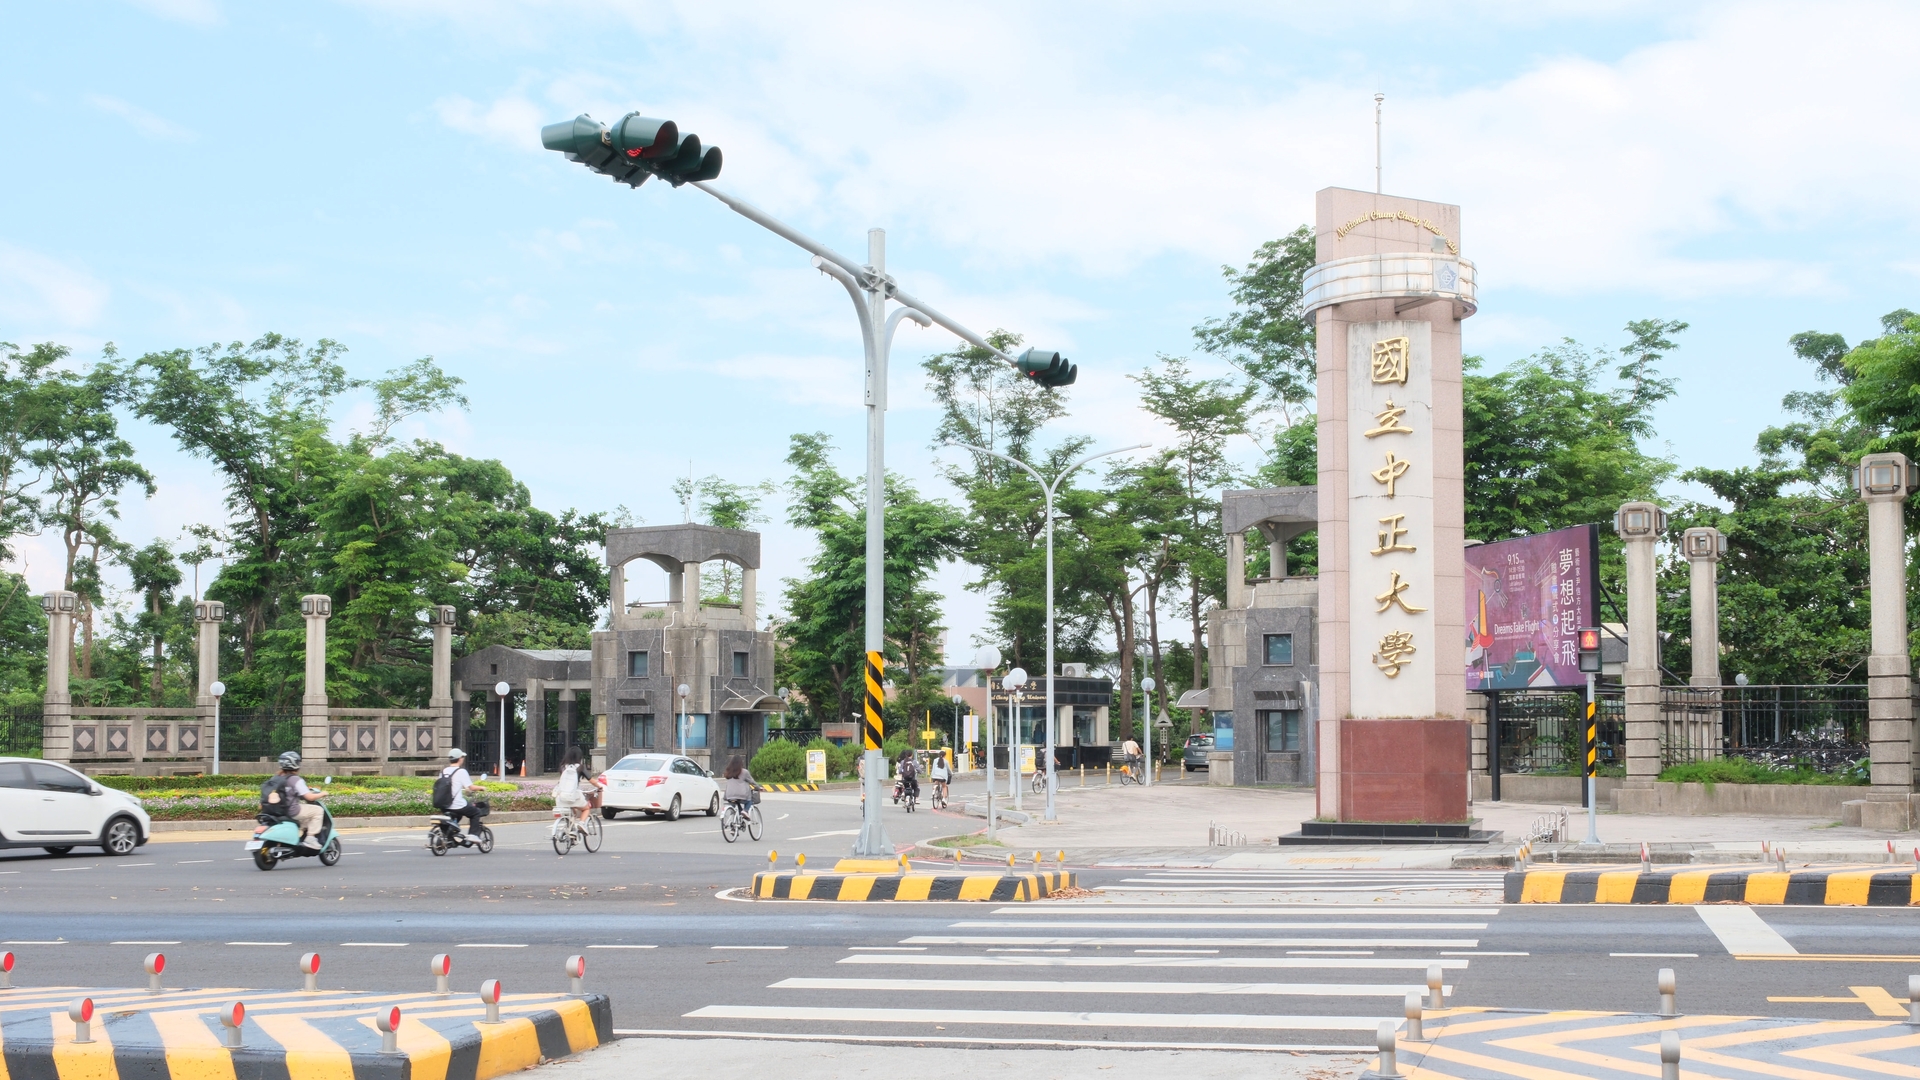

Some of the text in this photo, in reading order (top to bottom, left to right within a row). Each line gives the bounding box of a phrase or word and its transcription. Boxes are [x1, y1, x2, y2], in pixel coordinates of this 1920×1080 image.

[1336, 209, 1459, 255] National Chung Cheng Univesity
[1364, 337, 1428, 679] 國立中正大學
[1507, 553, 1519, 565] 9.15
[1495, 620, 1539, 634] Dreams Take Flight
[1559, 548, 1575, 666] 夢想起飛
